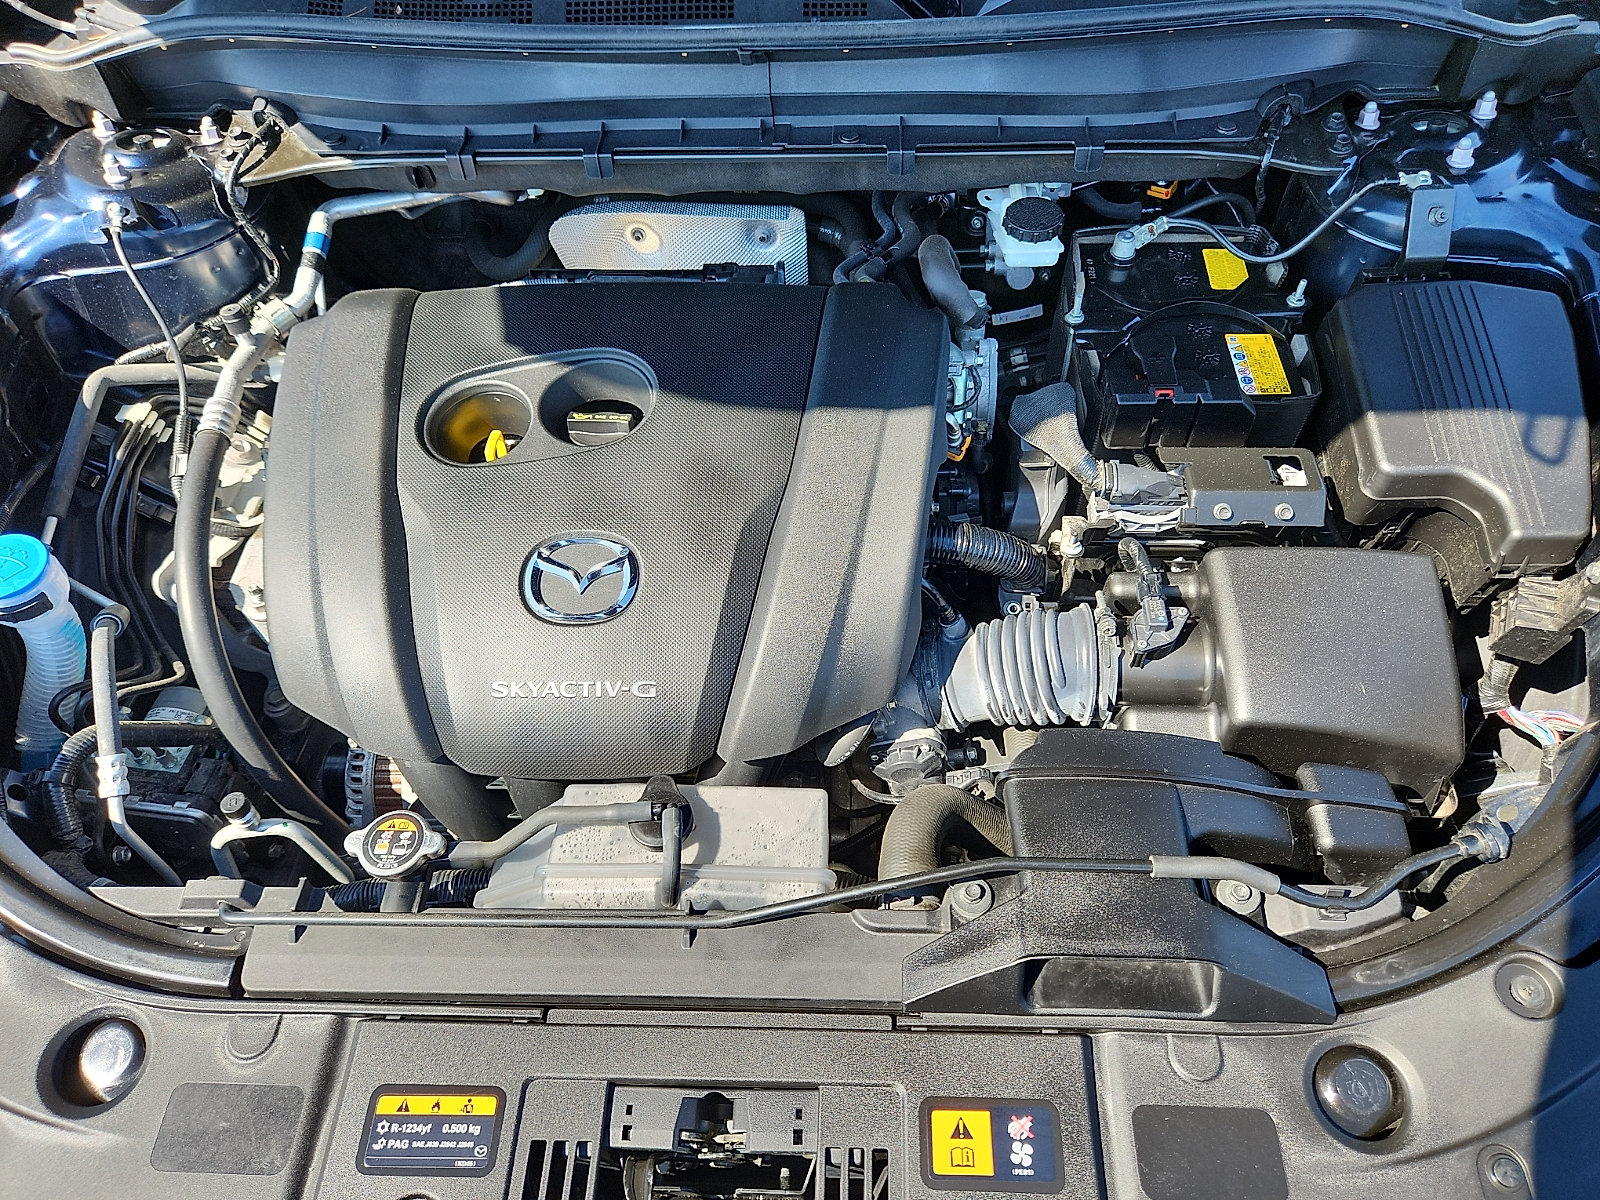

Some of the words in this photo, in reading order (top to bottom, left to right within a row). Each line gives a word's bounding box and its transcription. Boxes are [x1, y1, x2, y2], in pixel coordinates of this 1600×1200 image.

[490, 680, 657, 699] SKYACTIV-G
[391, 1123, 432, 1135] R-1234yf
[442, 1123, 468, 1133] 0.500
[468, 1124, 481, 1135] kg
[387, 1139, 410, 1149] PAG
